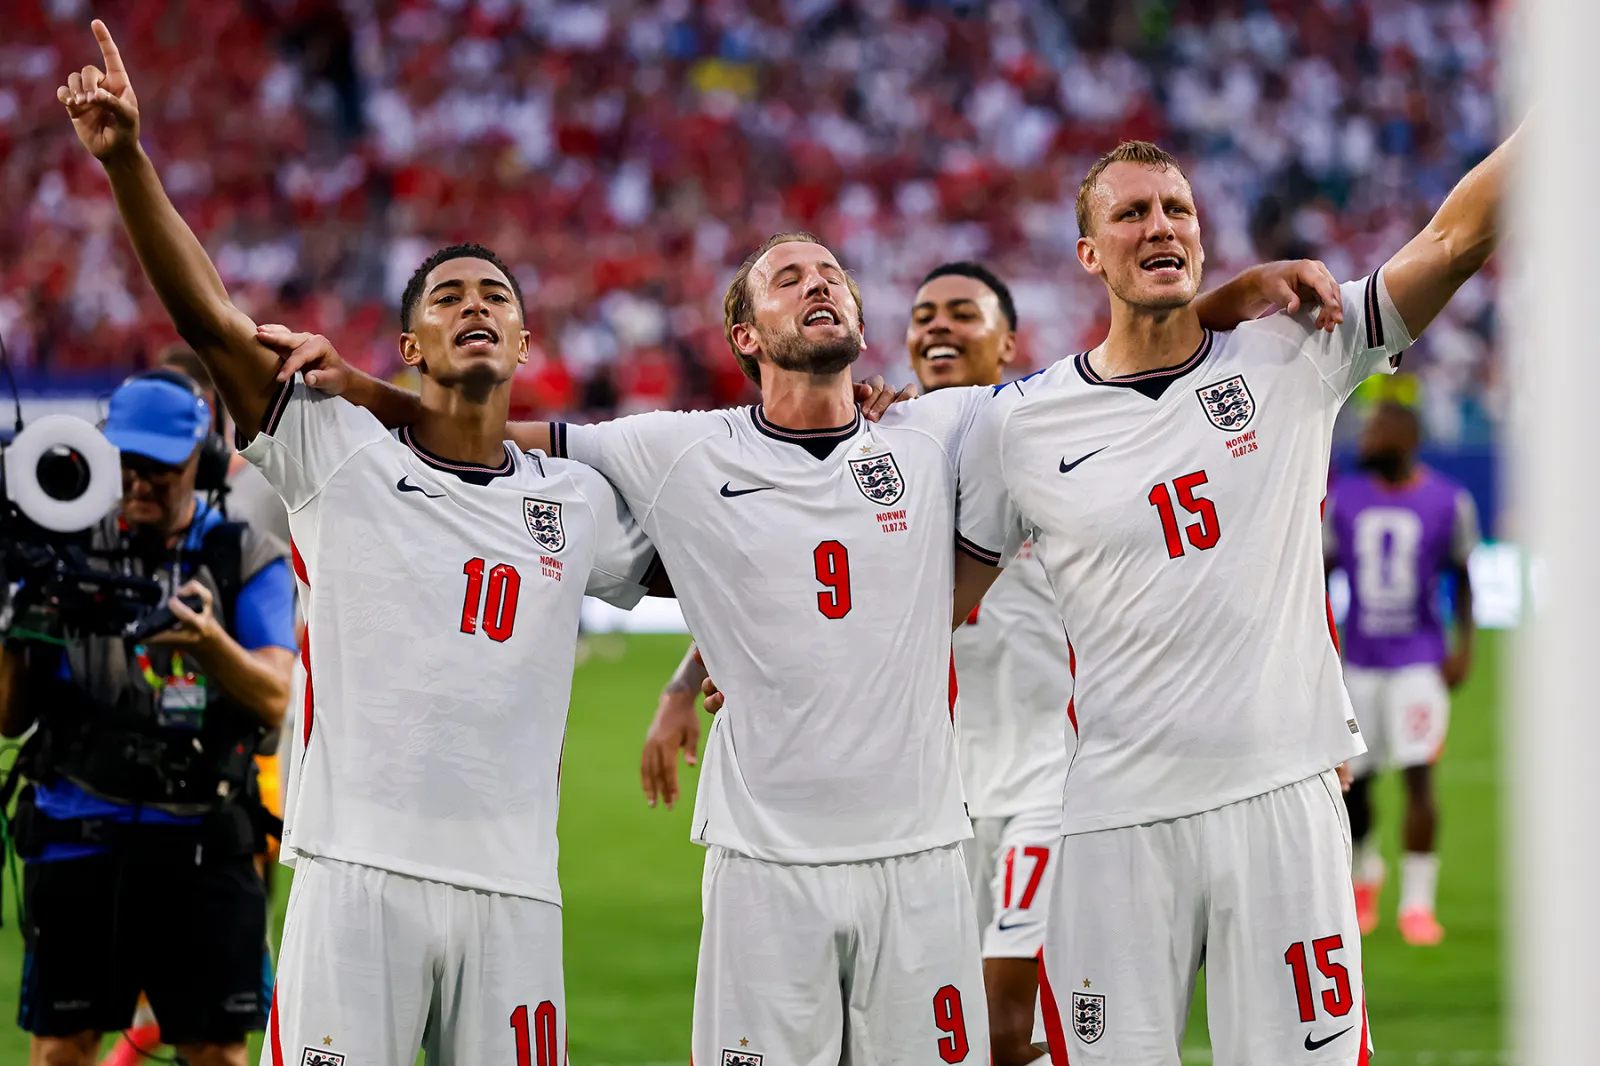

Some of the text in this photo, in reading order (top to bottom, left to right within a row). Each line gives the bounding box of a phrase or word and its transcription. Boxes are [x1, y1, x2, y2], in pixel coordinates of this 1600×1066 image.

[1225, 430, 1257, 449] NORWAY
[1231, 442, 1259, 459] 11.07.26
[875, 510, 907, 522] NORWAY
[881, 521, 908, 533] 11.07.26
[1147, 470, 1222, 560] 15
[539, 555, 563, 571] NORWAY
[813, 540, 852, 620] 9
[459, 556, 522, 643] 10
[1003, 845, 1051, 911] 17
[1284, 934, 1354, 1023] 15
[509, 1000, 558, 1066] 10
[932, 984, 970, 1065] 9
